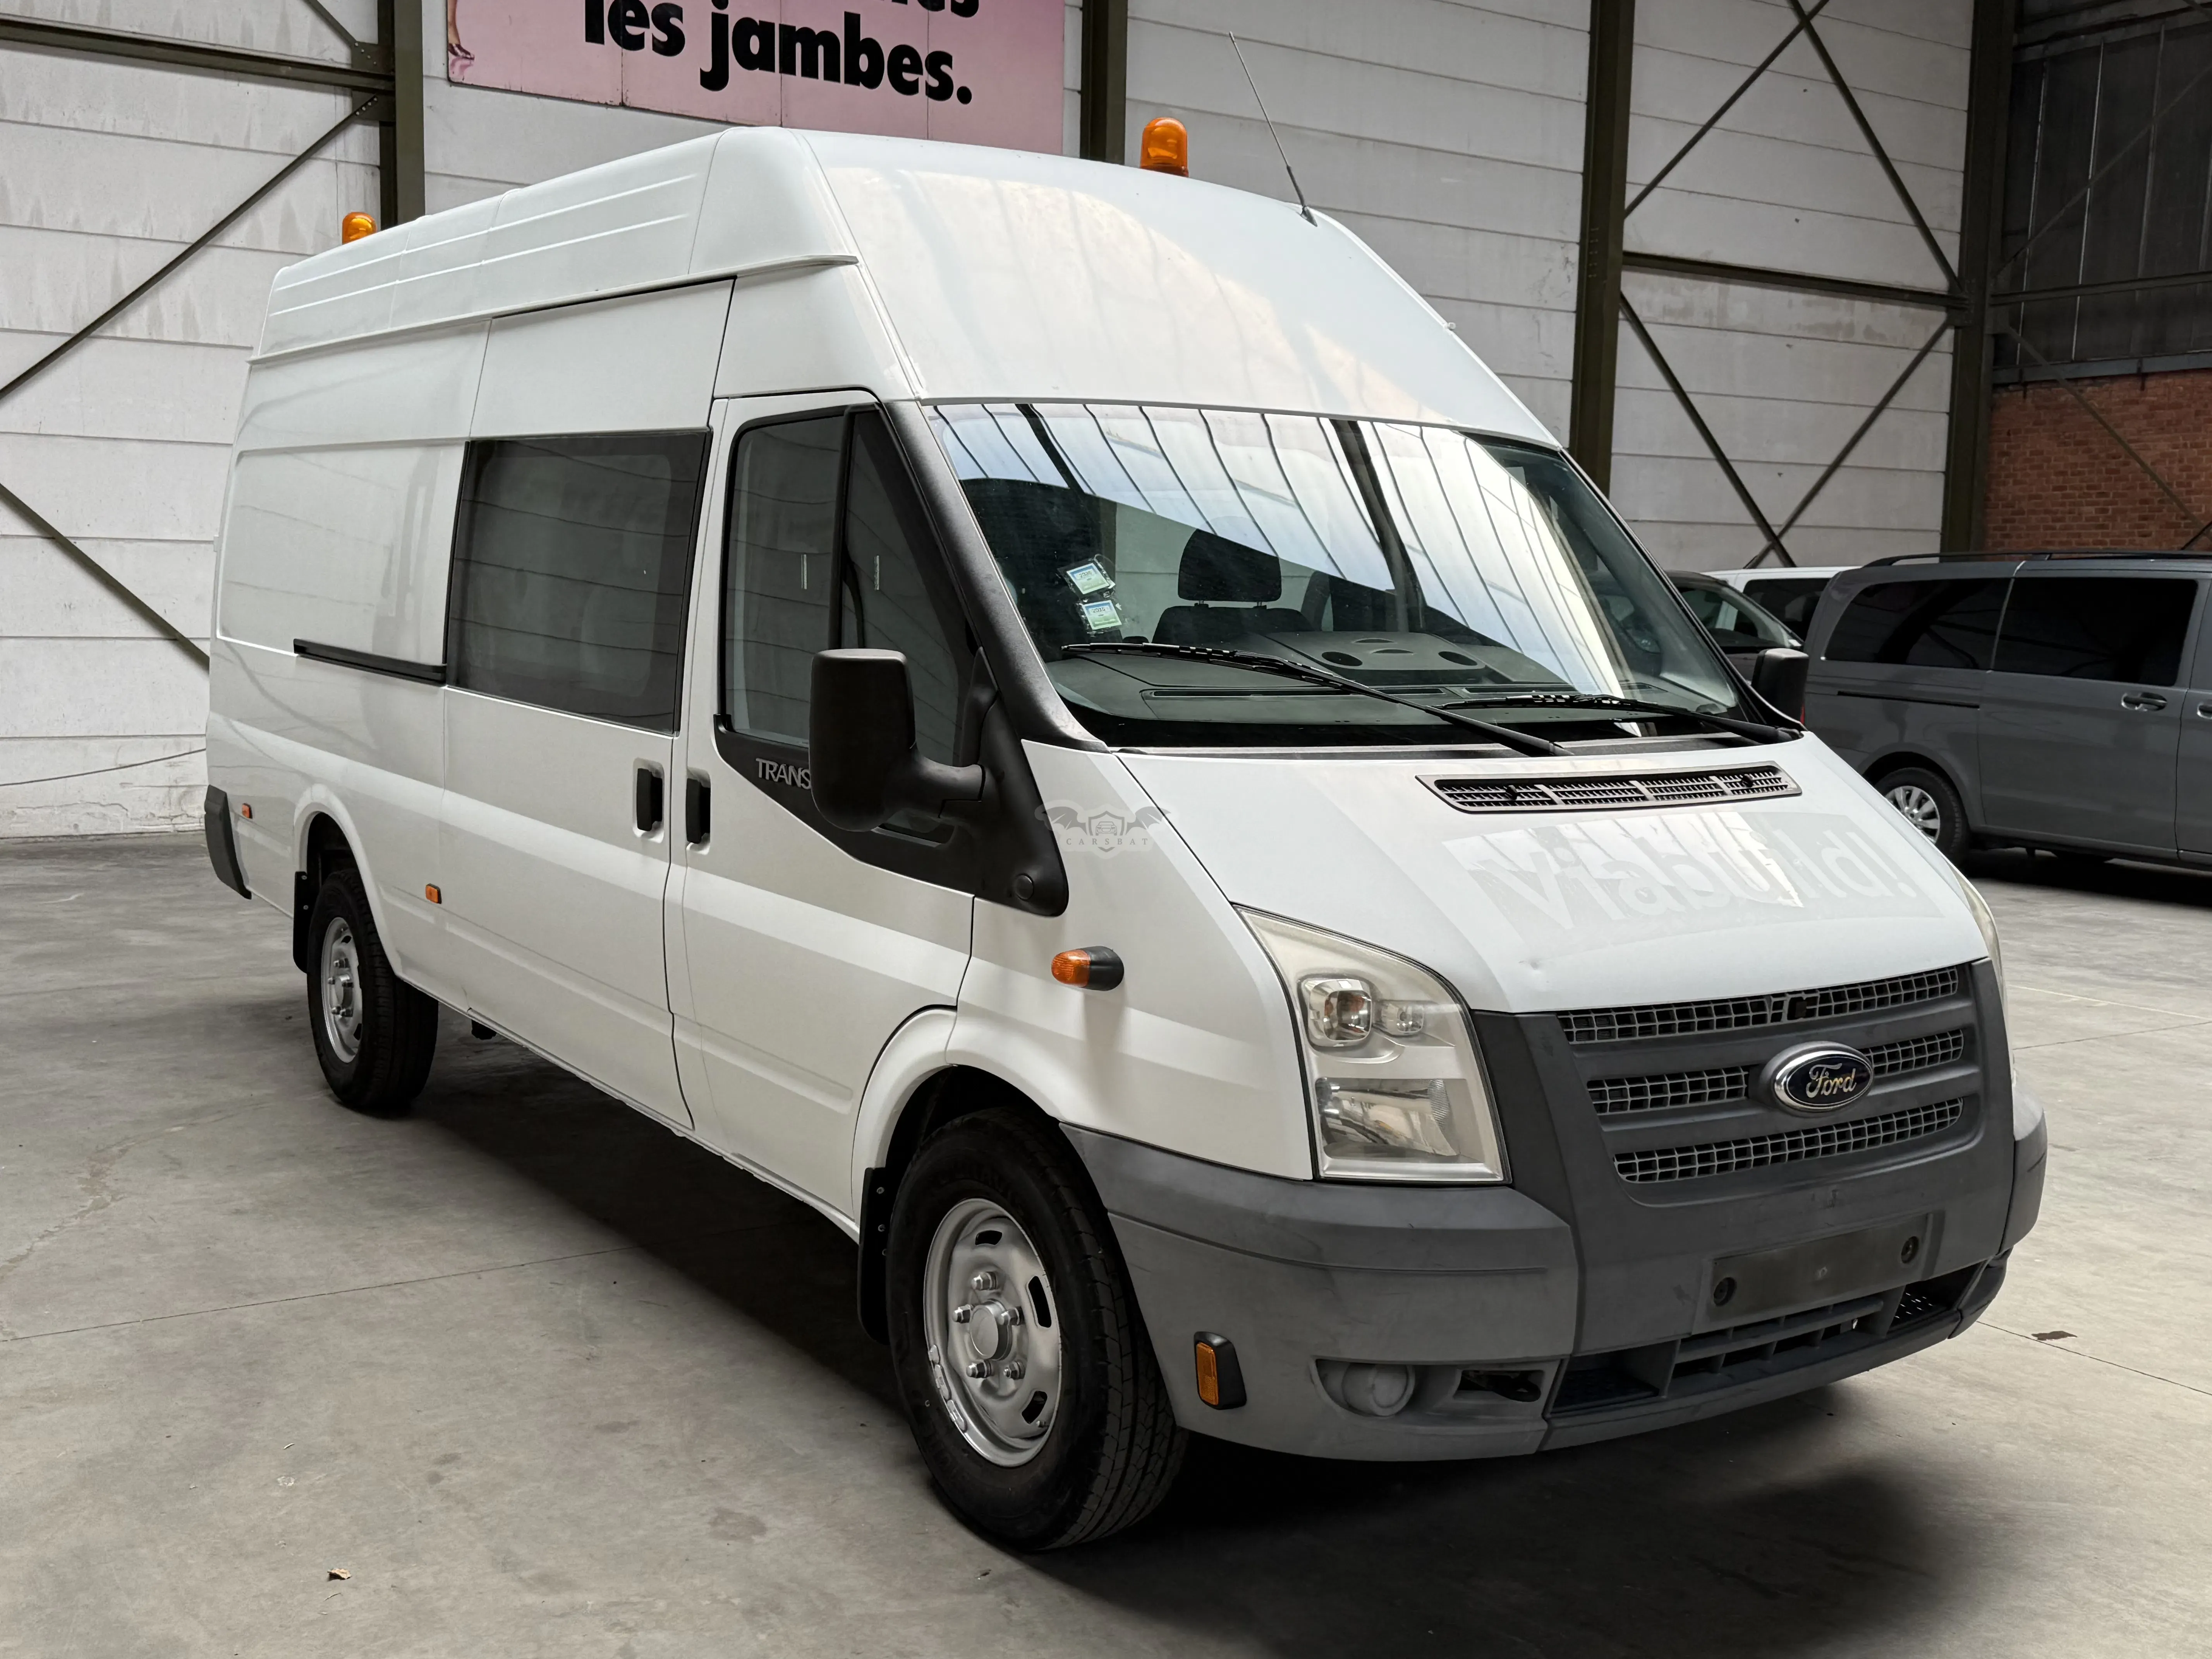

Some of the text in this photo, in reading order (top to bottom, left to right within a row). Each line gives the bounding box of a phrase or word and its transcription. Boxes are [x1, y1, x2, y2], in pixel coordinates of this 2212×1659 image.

[585, 0, 972, 105] les jambes.
[756, 757, 812, 790] TRANS
[1806, 1063, 1857, 1098] Ford
